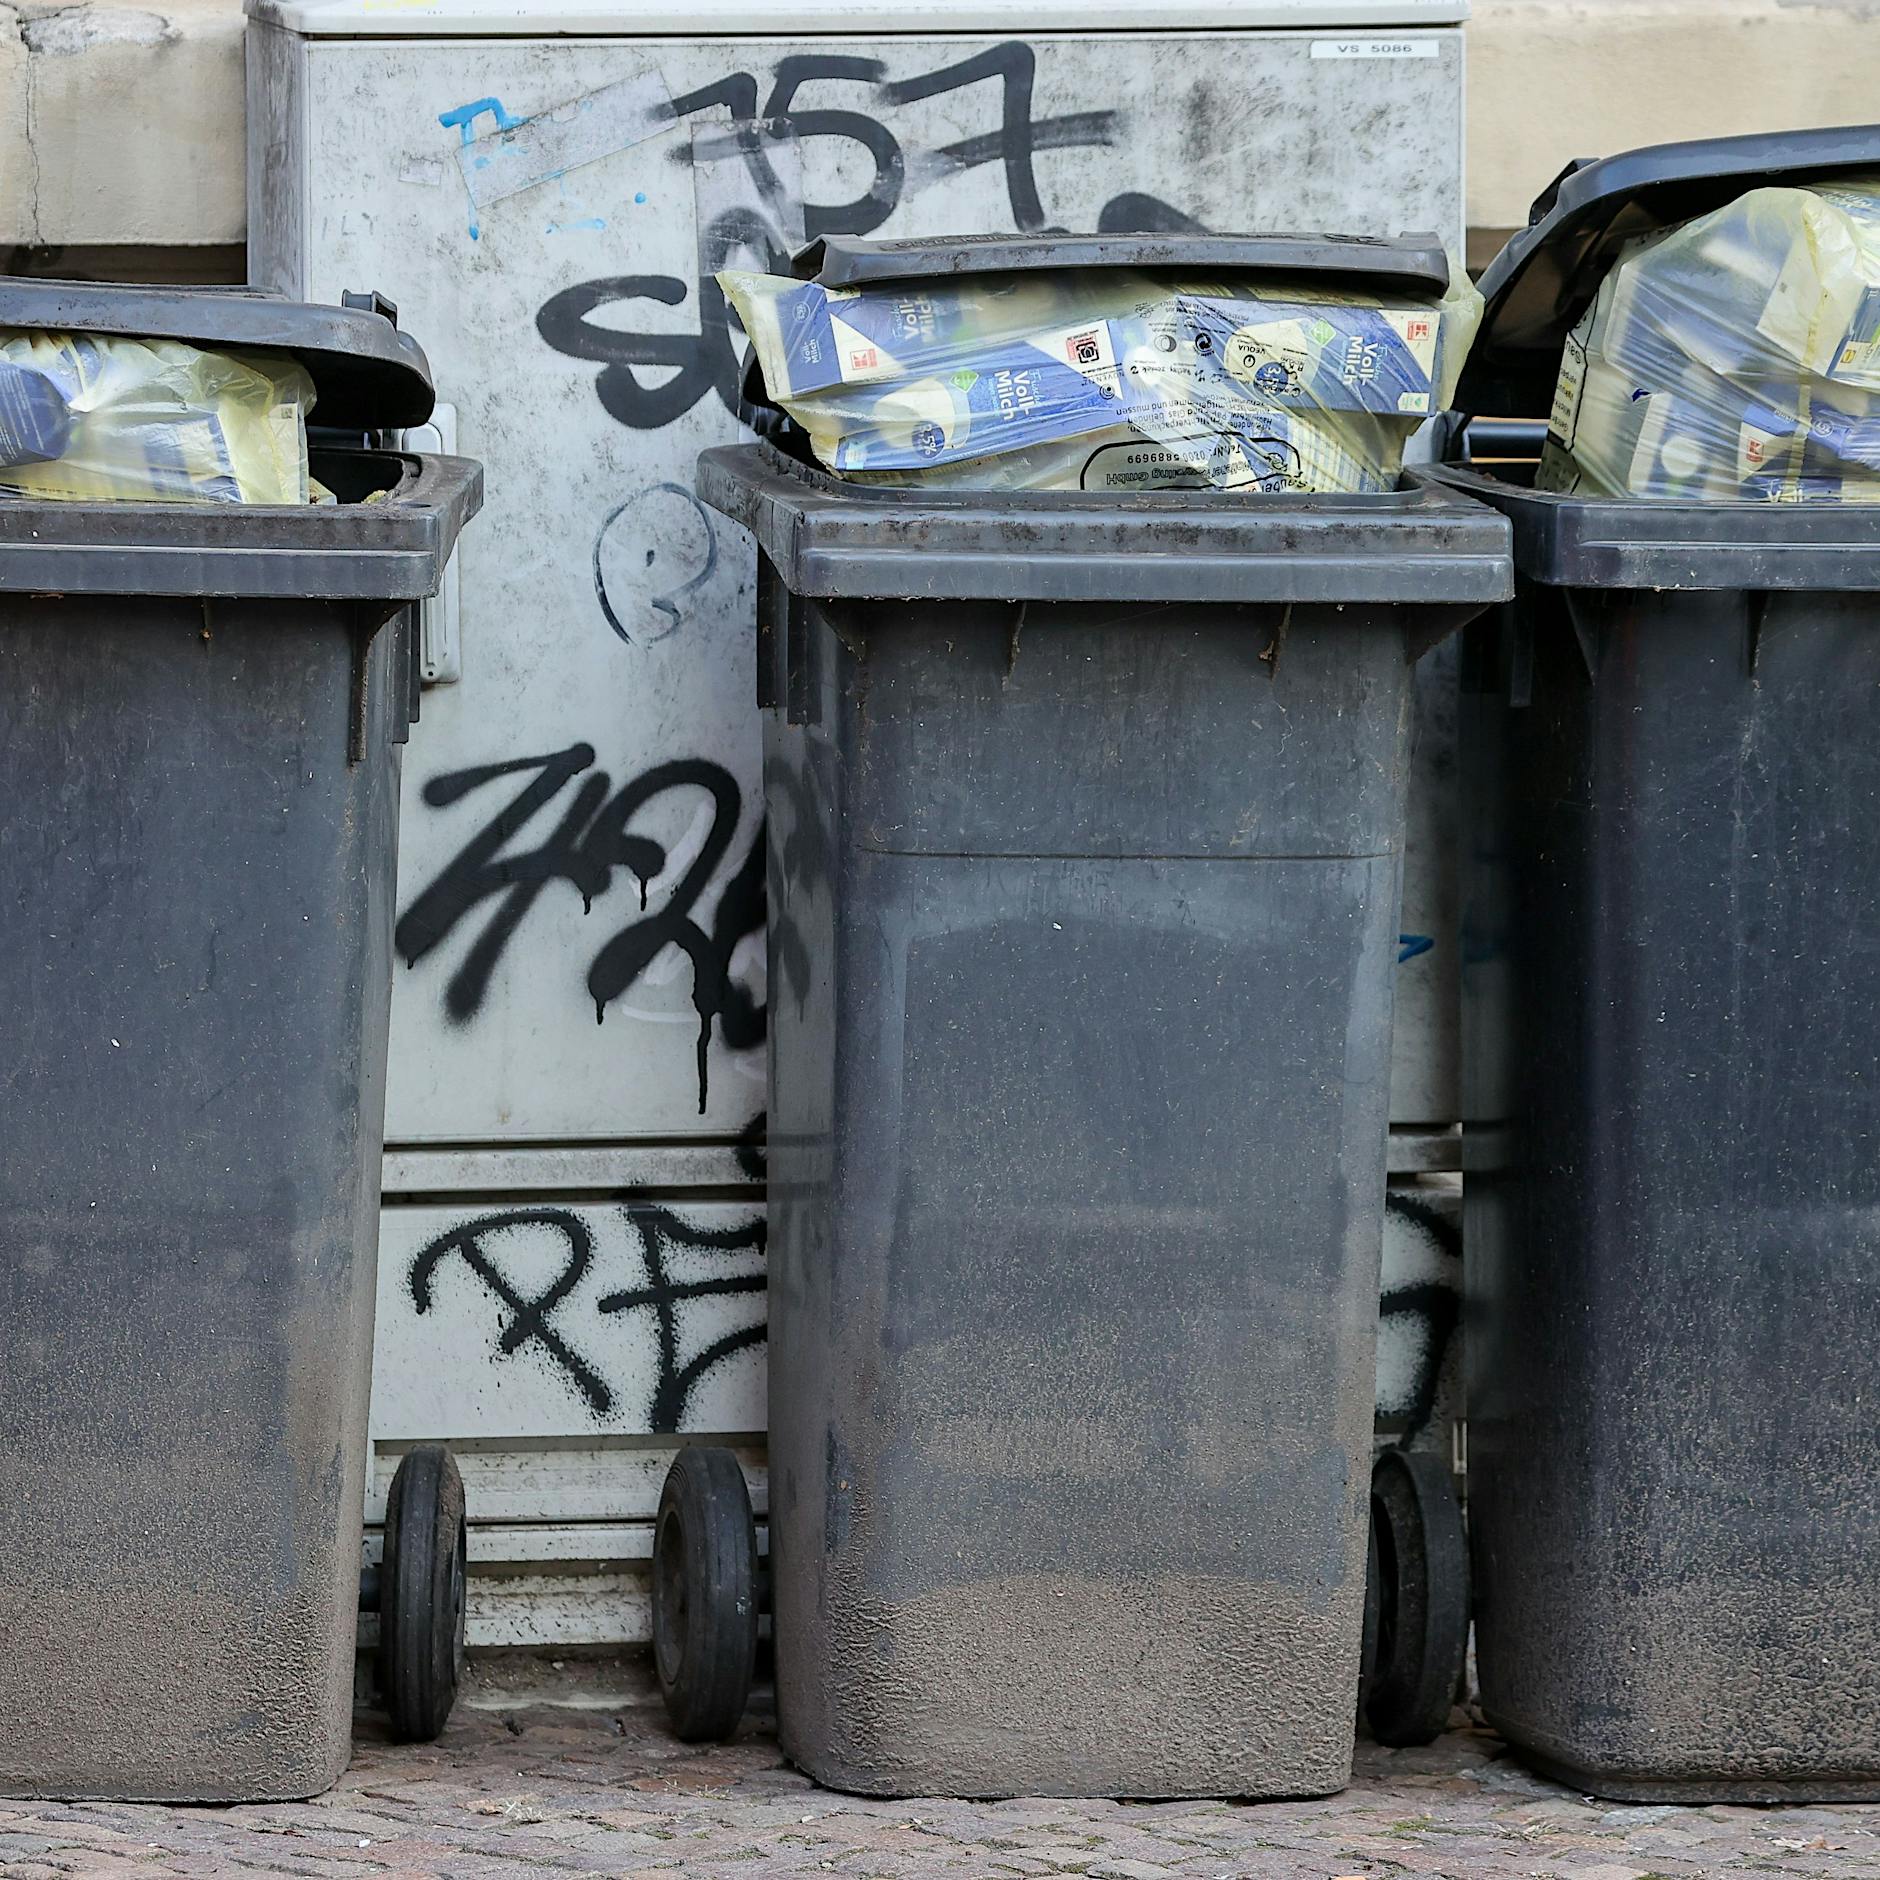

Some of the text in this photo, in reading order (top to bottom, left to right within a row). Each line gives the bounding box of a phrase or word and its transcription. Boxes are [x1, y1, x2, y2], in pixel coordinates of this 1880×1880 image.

[1337, 44, 1413, 53] VS 5086
[811, 338, 821, 366] Milch
[1238, 344, 1266, 355] VEOLIA
[1344, 335, 1364, 385] Milch
[1359, 342, 1379, 386] Voll-
[993, 370, 1014, 421] Milch
[1012, 370, 1031, 418] Voll-
[1151, 402, 1168, 411] und
[1168, 409, 1186, 419] Glas
[1127, 451, 1180, 465] 5889699
[1106, 471, 1150, 485] GmbH
